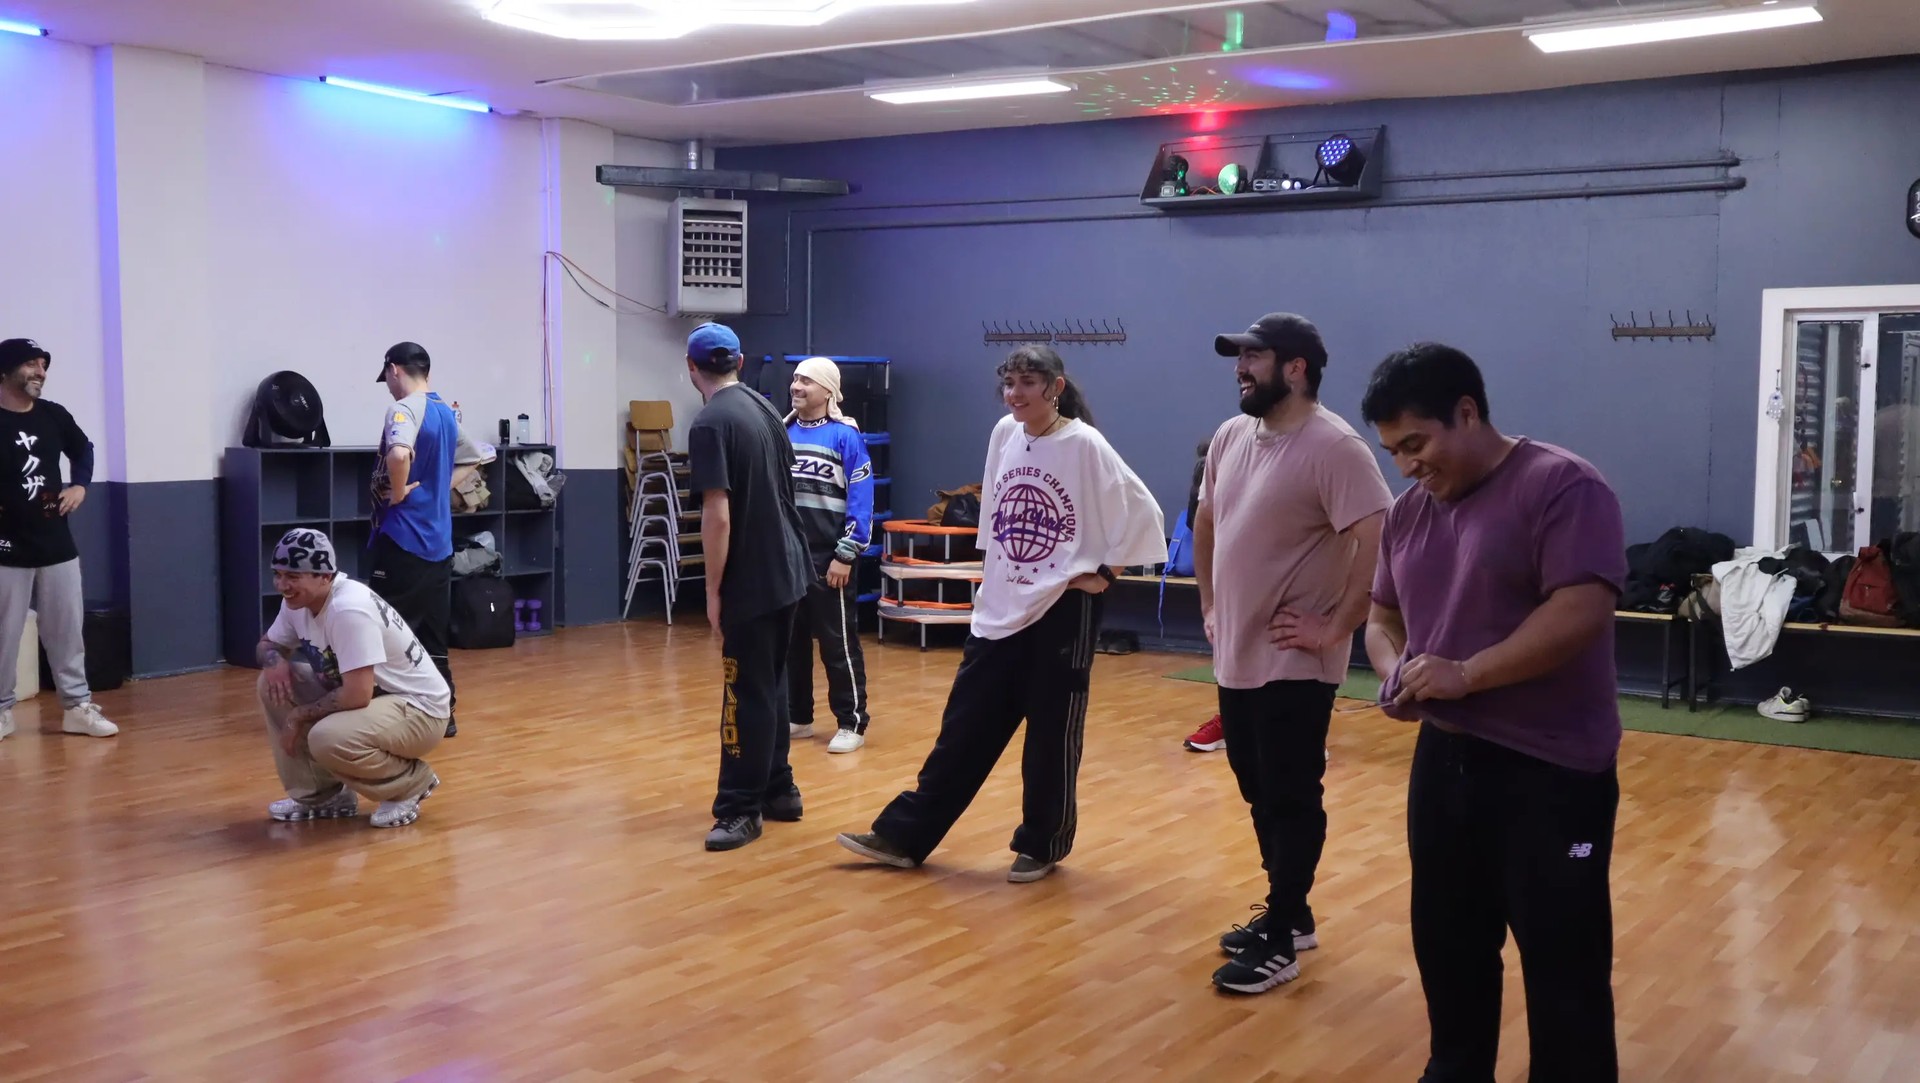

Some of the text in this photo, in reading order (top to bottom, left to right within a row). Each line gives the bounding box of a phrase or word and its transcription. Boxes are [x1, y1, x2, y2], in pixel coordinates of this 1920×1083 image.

[15, 431, 46, 501] ヤクザ
[1002, 466, 1041, 483] SERIES
[1043, 473, 1076, 542] CHAMPIONS
